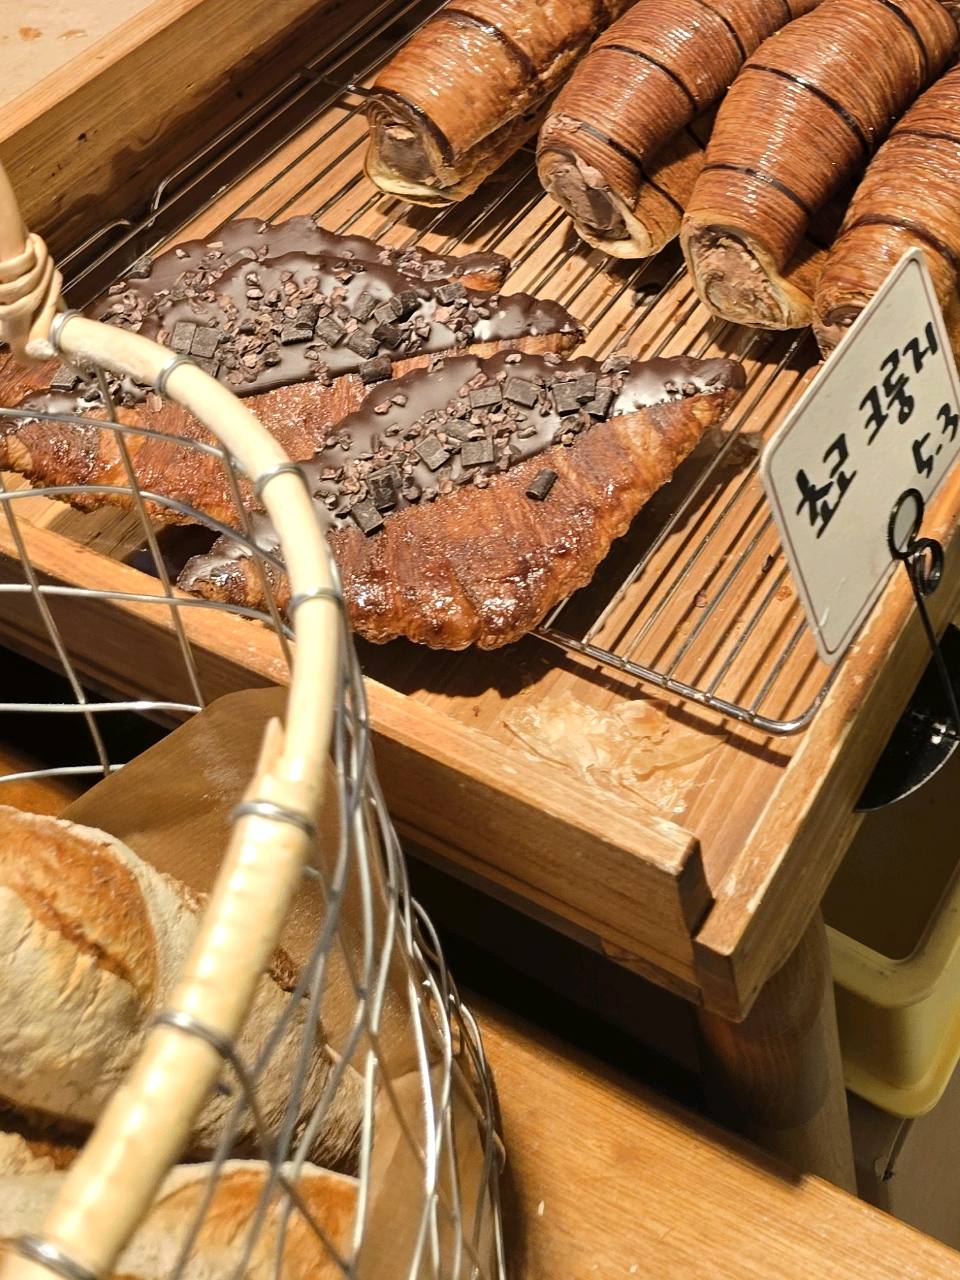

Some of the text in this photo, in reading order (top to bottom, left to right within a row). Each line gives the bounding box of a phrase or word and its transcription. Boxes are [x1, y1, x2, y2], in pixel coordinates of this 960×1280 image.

[796, 321, 941, 540] 초코 크룽지
[911, 402, 960, 480] 5.3
